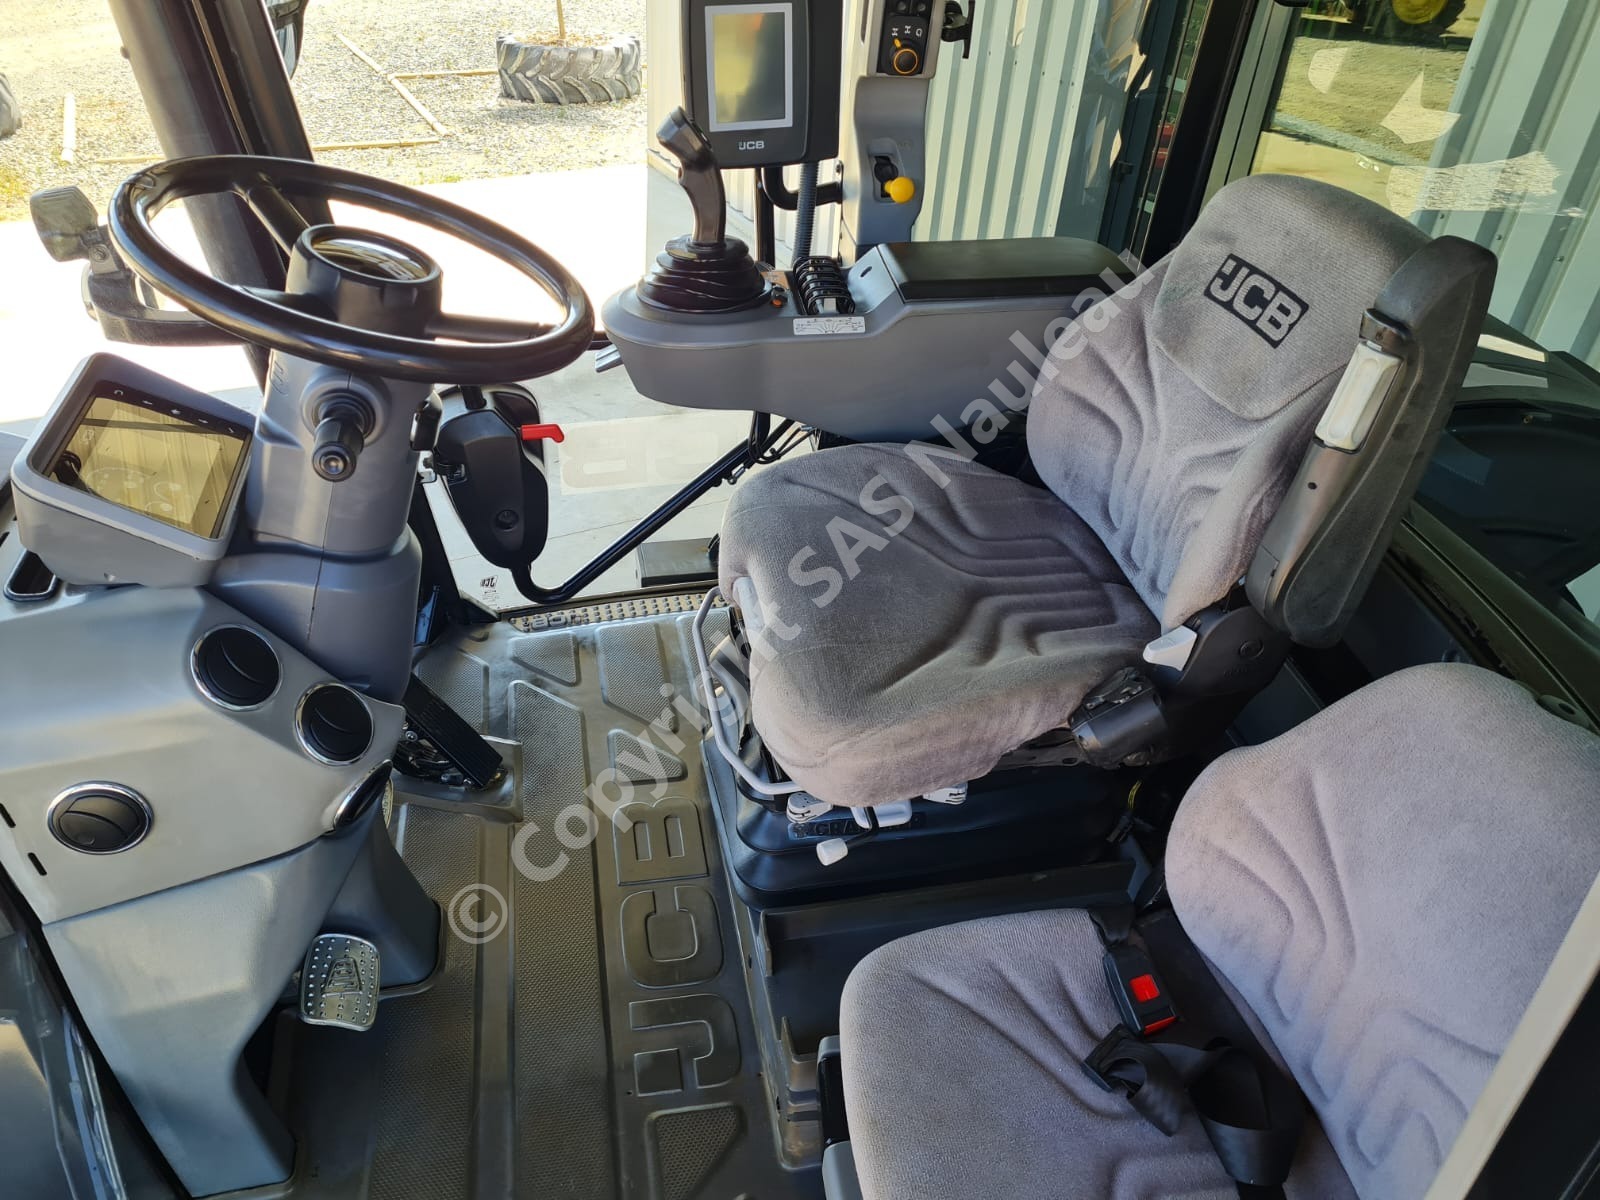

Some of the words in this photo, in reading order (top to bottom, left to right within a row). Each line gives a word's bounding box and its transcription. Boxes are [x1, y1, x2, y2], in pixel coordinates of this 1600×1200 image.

[738, 140, 765, 151] JCB
[1208, 257, 1304, 343] JCB
[611, 796, 743, 1098] JCB
